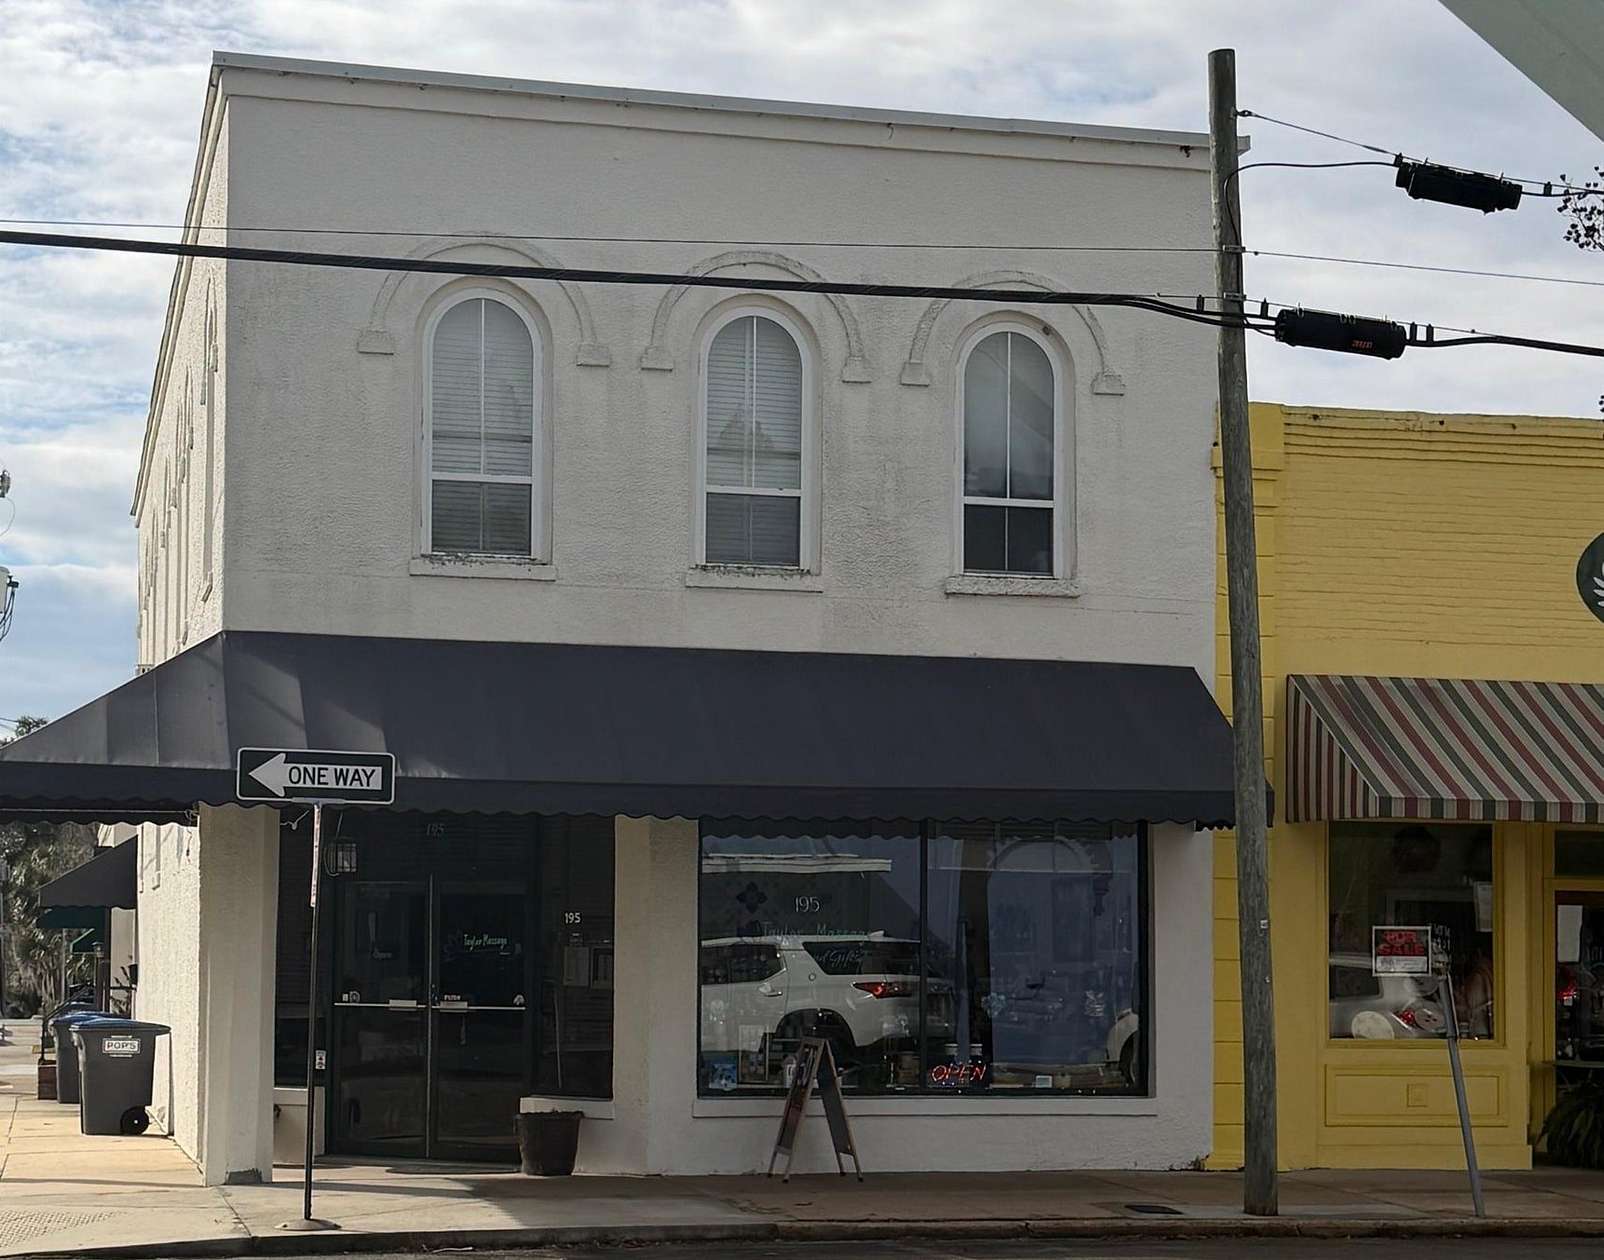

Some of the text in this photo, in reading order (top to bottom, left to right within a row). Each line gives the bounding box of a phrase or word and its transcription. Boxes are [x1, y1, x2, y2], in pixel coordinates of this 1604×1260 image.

[289, 766, 376, 787] ONE WAY
[794, 896, 820, 912] 195
[564, 912, 582, 924] 195
[1383, 931, 1417, 943] FOR
[1377, 943, 1425, 956] SALE
[931, 1062, 987, 1081] OPEN
